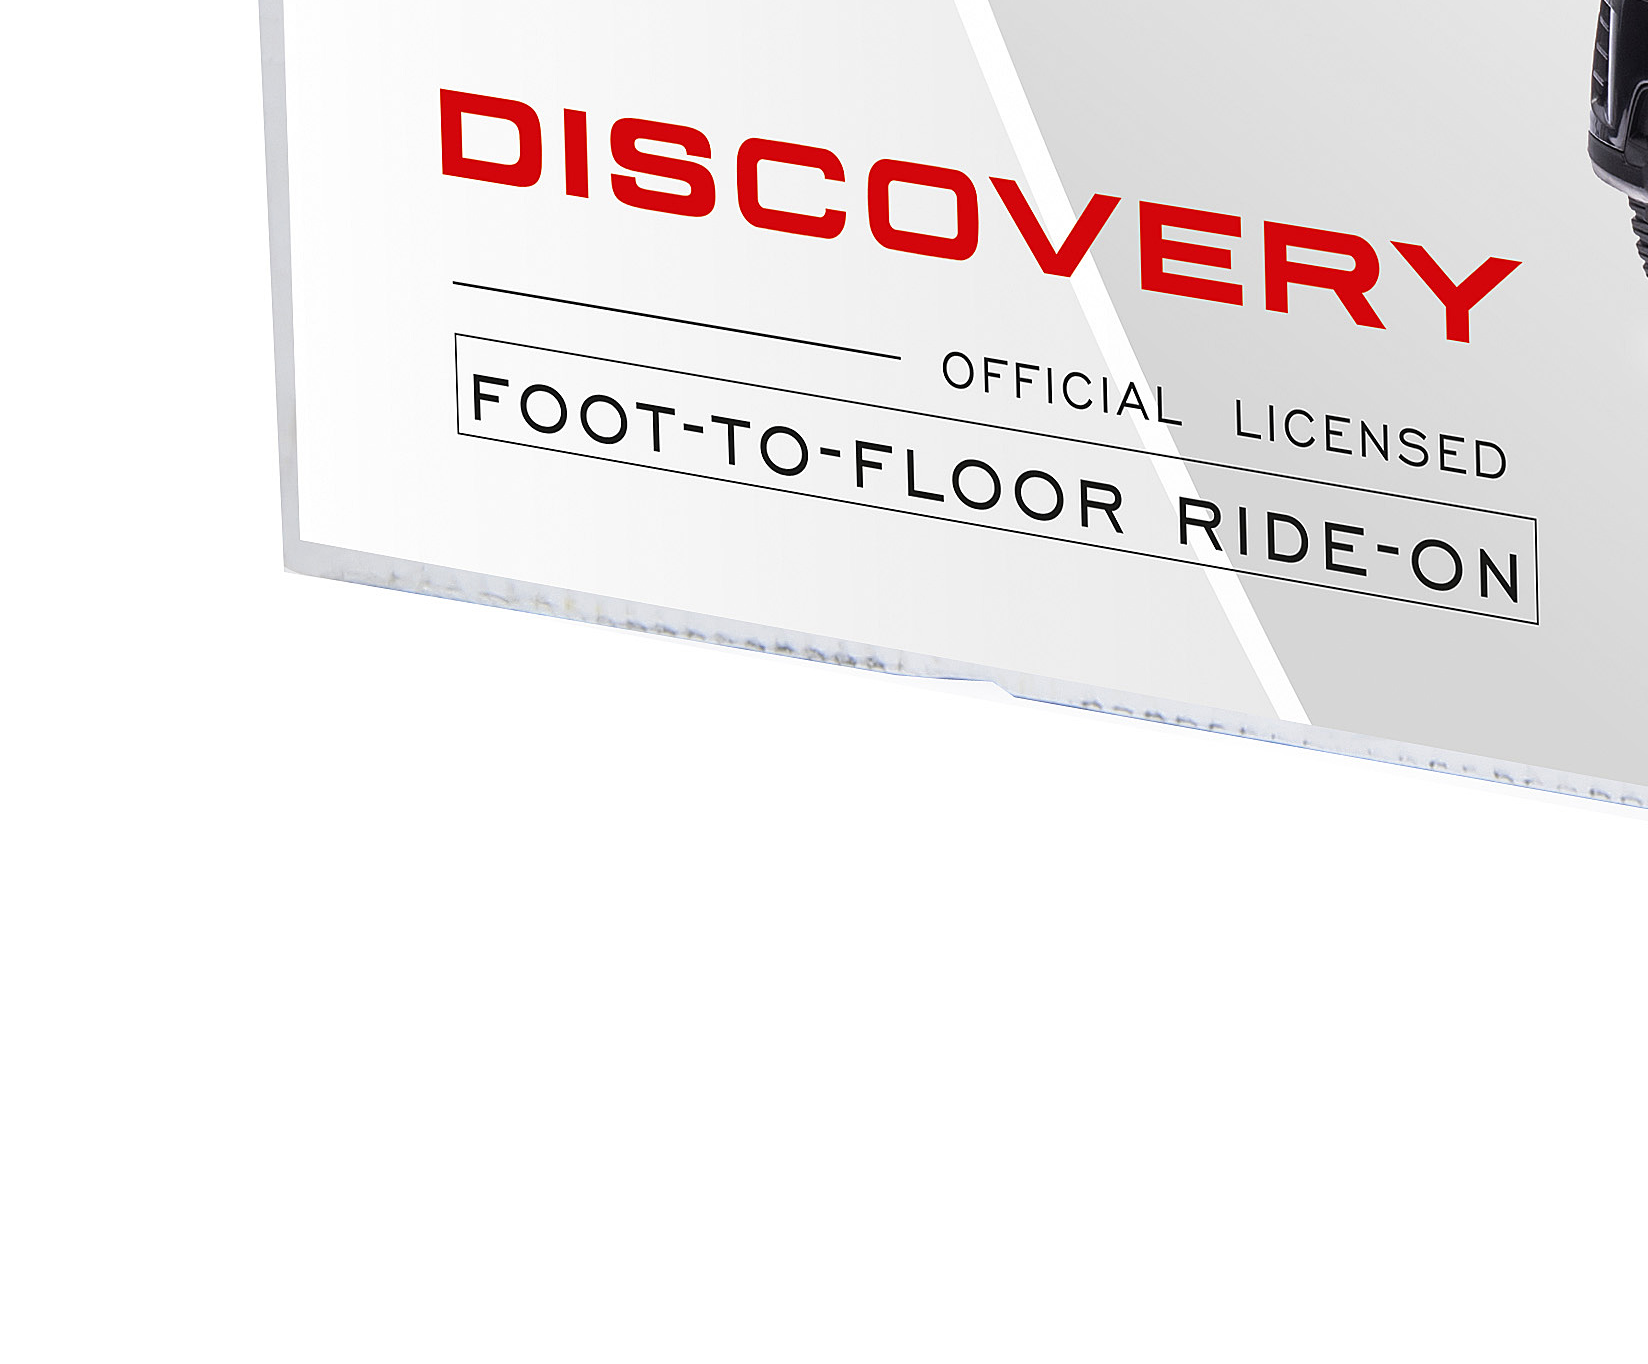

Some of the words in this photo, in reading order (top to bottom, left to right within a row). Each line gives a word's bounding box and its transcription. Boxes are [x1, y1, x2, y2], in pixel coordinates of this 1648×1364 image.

[439, 88, 1523, 343] DISCOVERY
[472, 373, 1124, 535] FOOT-TO-FLOOR
[1180, 495, 1519, 604] RIDE-ON
[943, 350, 1183, 428] OFFICIAL
[1234, 399, 1507, 481] LICENSED
